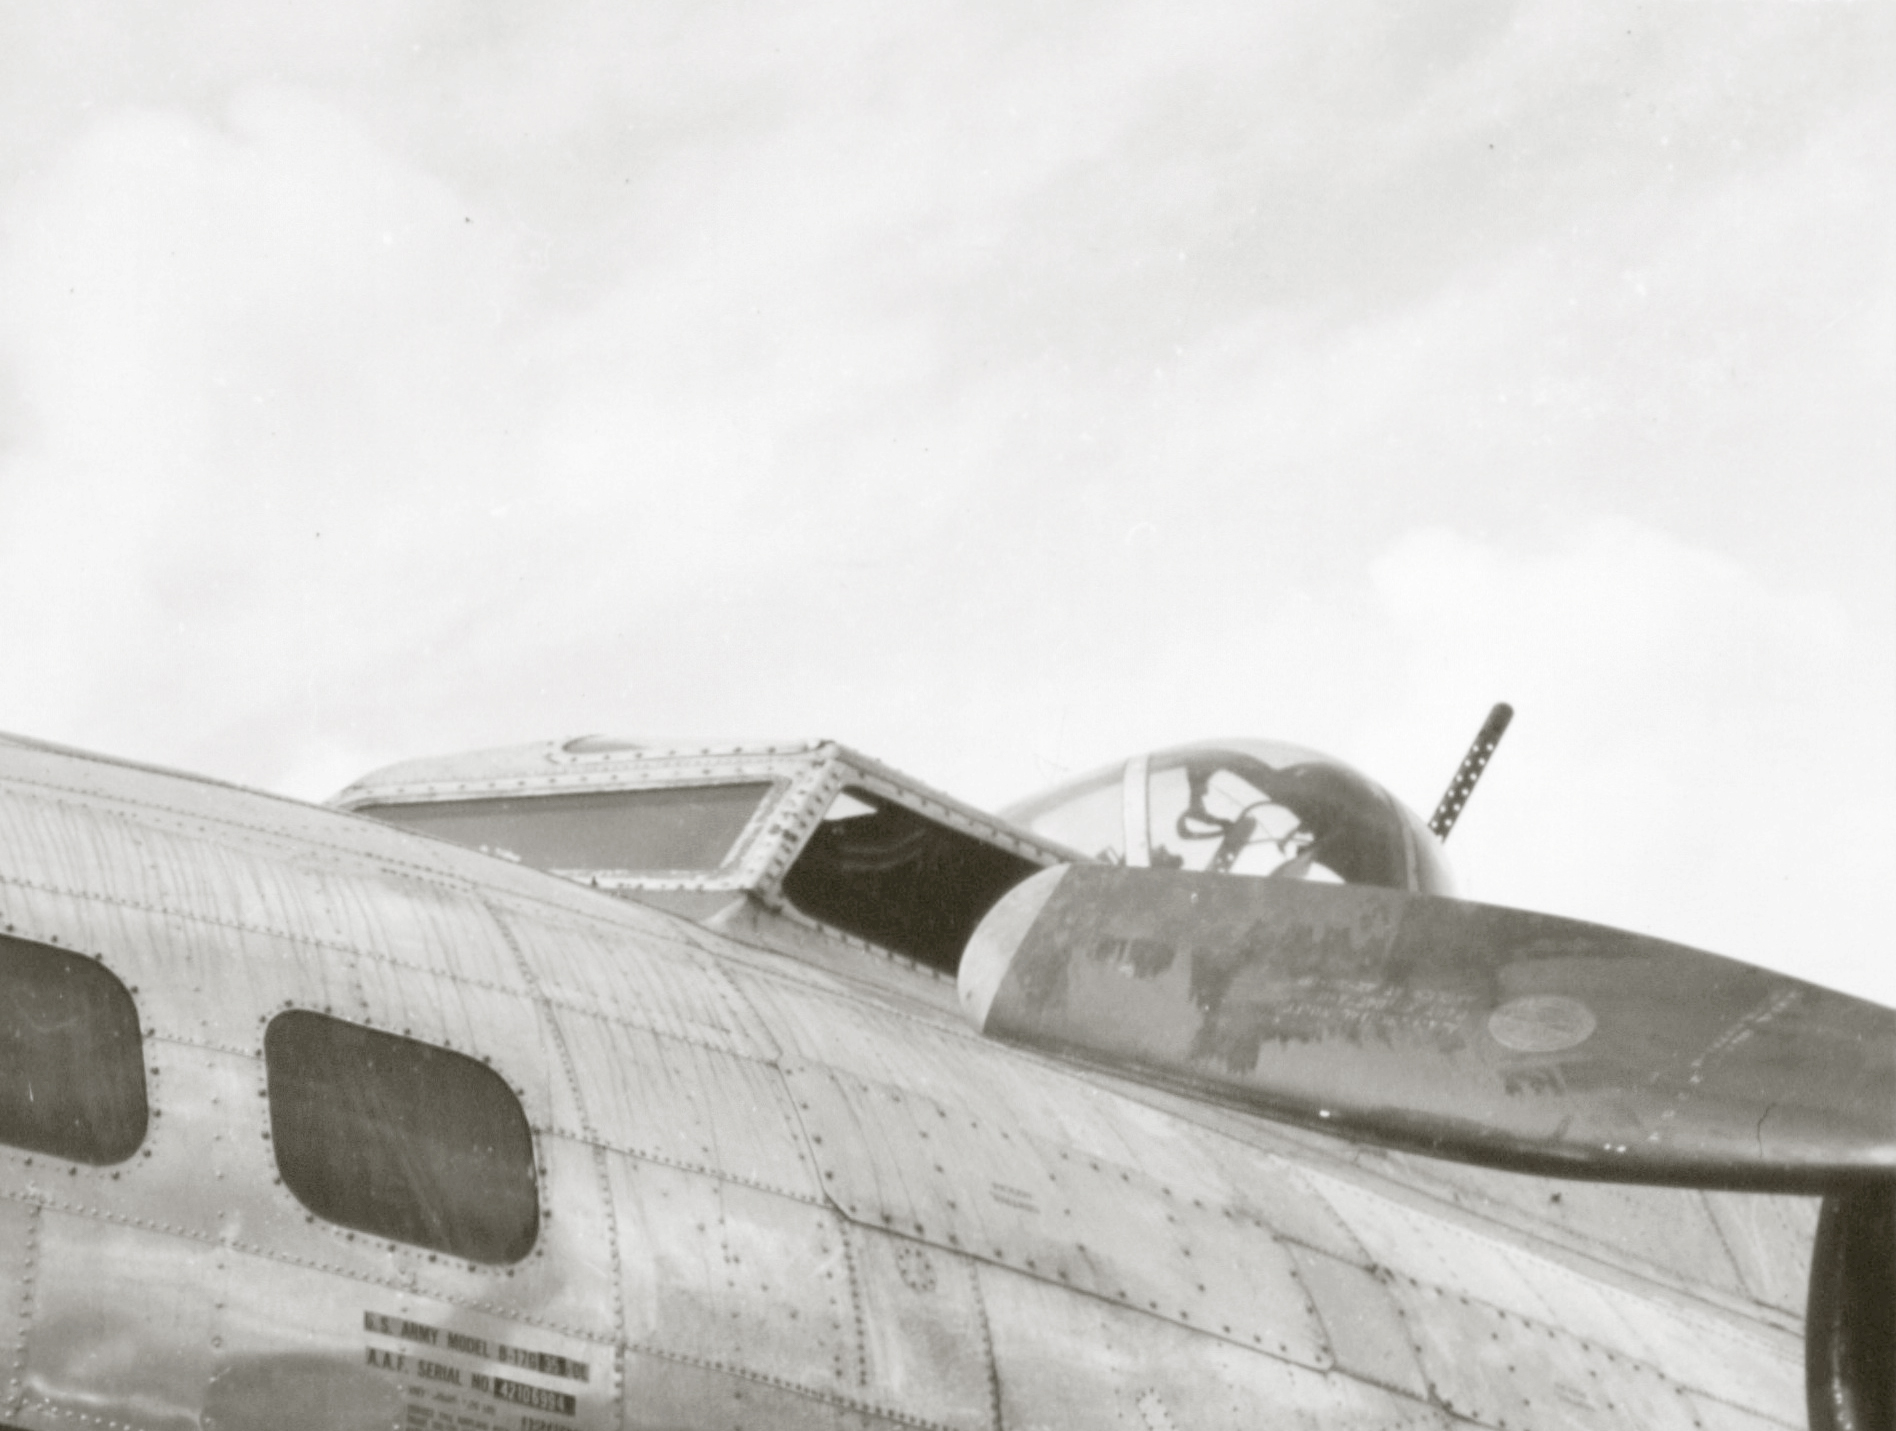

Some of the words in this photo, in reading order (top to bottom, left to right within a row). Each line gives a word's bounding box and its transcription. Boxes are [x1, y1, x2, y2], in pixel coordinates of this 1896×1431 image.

[400, 1318, 439, 1345] ARMY
[446, 1330, 489, 1358] MODEL
[417, 1358, 462, 1387] SERIAL
